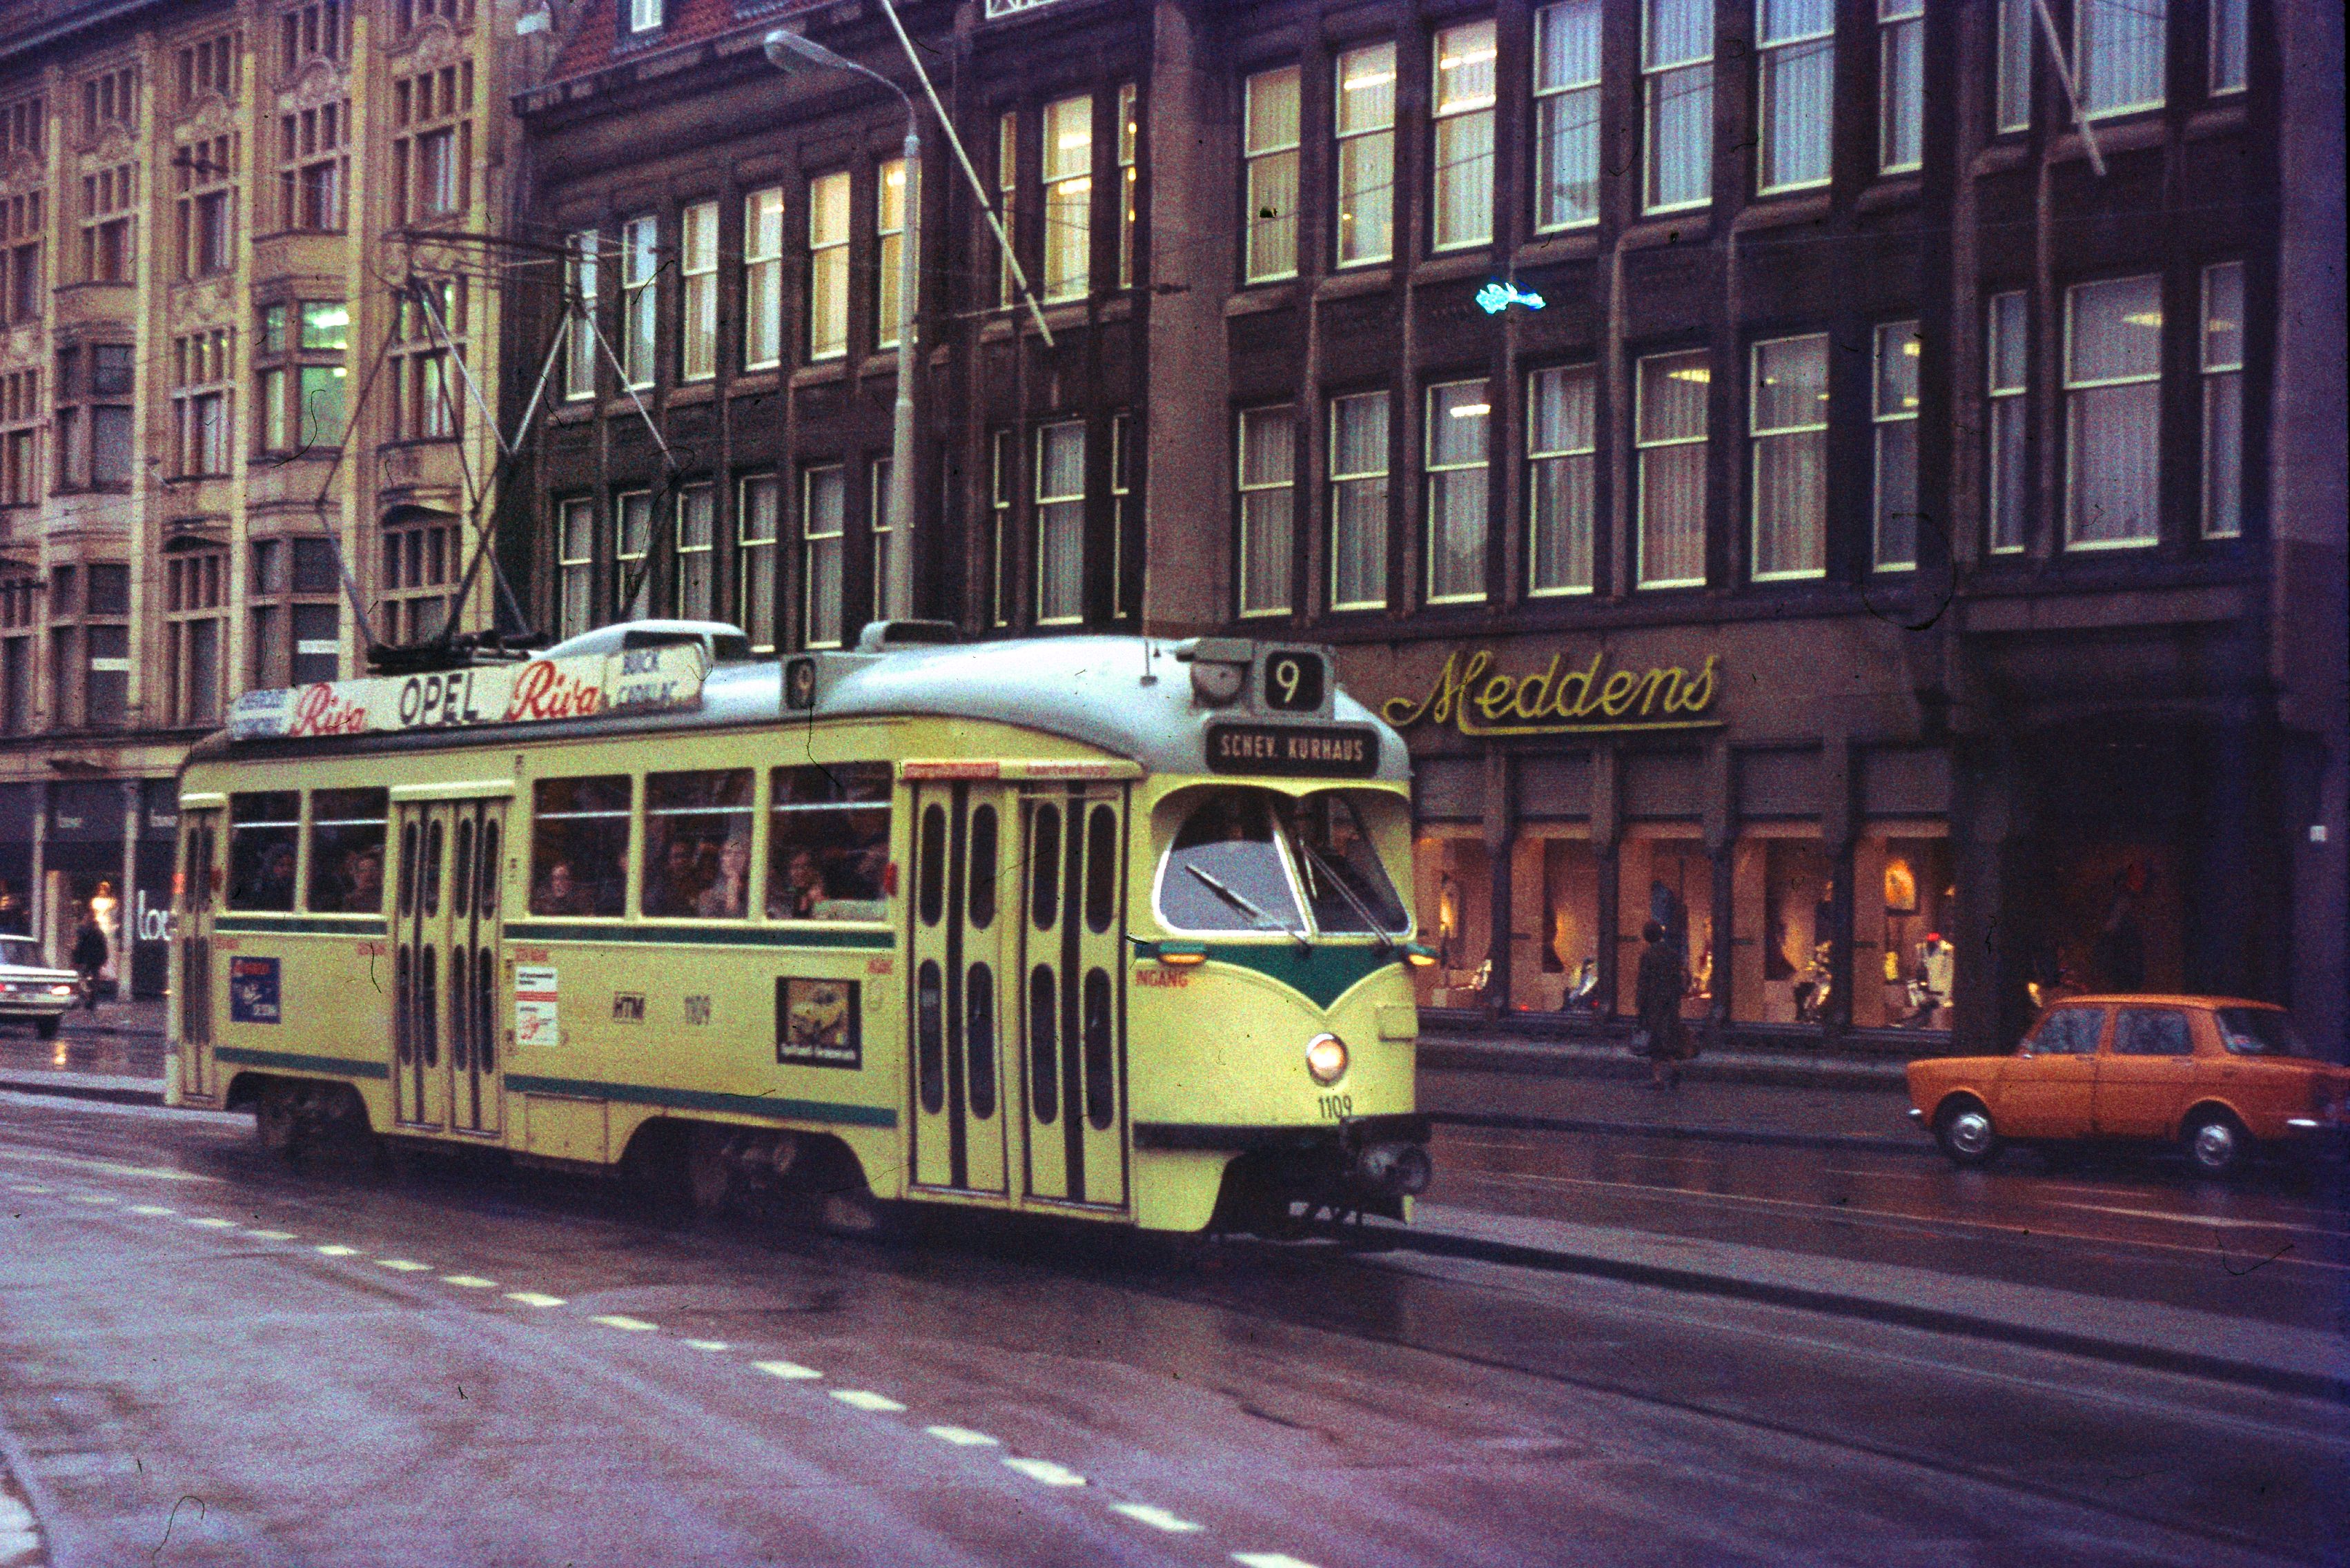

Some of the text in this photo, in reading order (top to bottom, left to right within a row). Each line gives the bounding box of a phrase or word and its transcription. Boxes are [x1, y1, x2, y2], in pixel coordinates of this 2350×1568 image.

[400, 672, 479, 725] OPEL
[1277, 659, 1300, 703] 9
[1381, 649, 1723, 736] Meddens
[1287, 736, 1364, 762] KURHAUS
[1318, 1095, 1352, 1119] 1109
